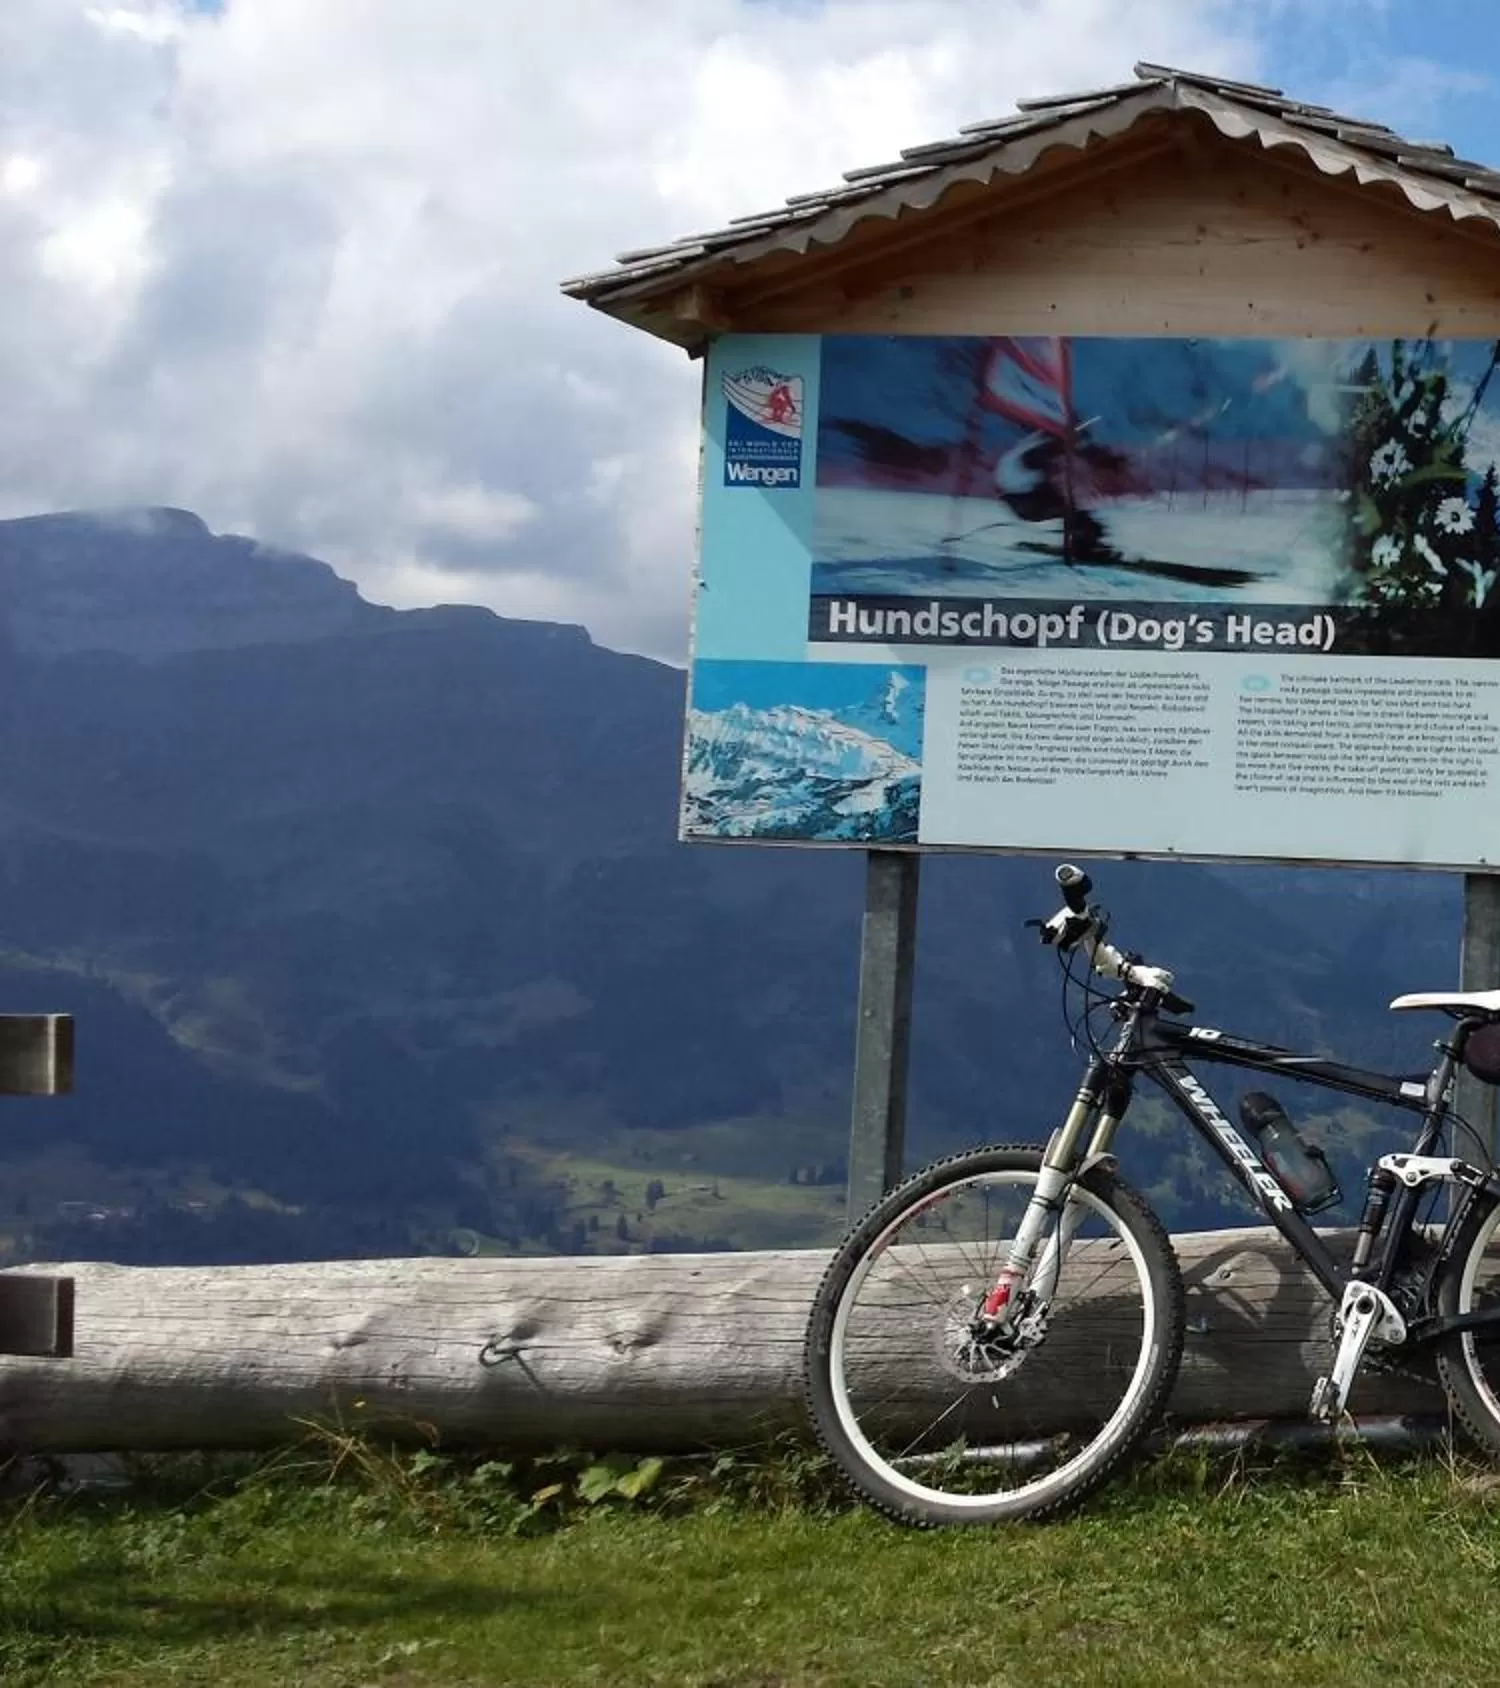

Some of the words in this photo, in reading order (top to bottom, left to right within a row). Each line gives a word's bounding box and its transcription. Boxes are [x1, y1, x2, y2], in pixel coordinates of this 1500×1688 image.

[727, 462, 798, 484] Wengen
[828, 601, 1085, 646] Hundschopf
[1226, 615, 1336, 651] Head)
[1179, 1075, 1293, 1213] WHEELER
